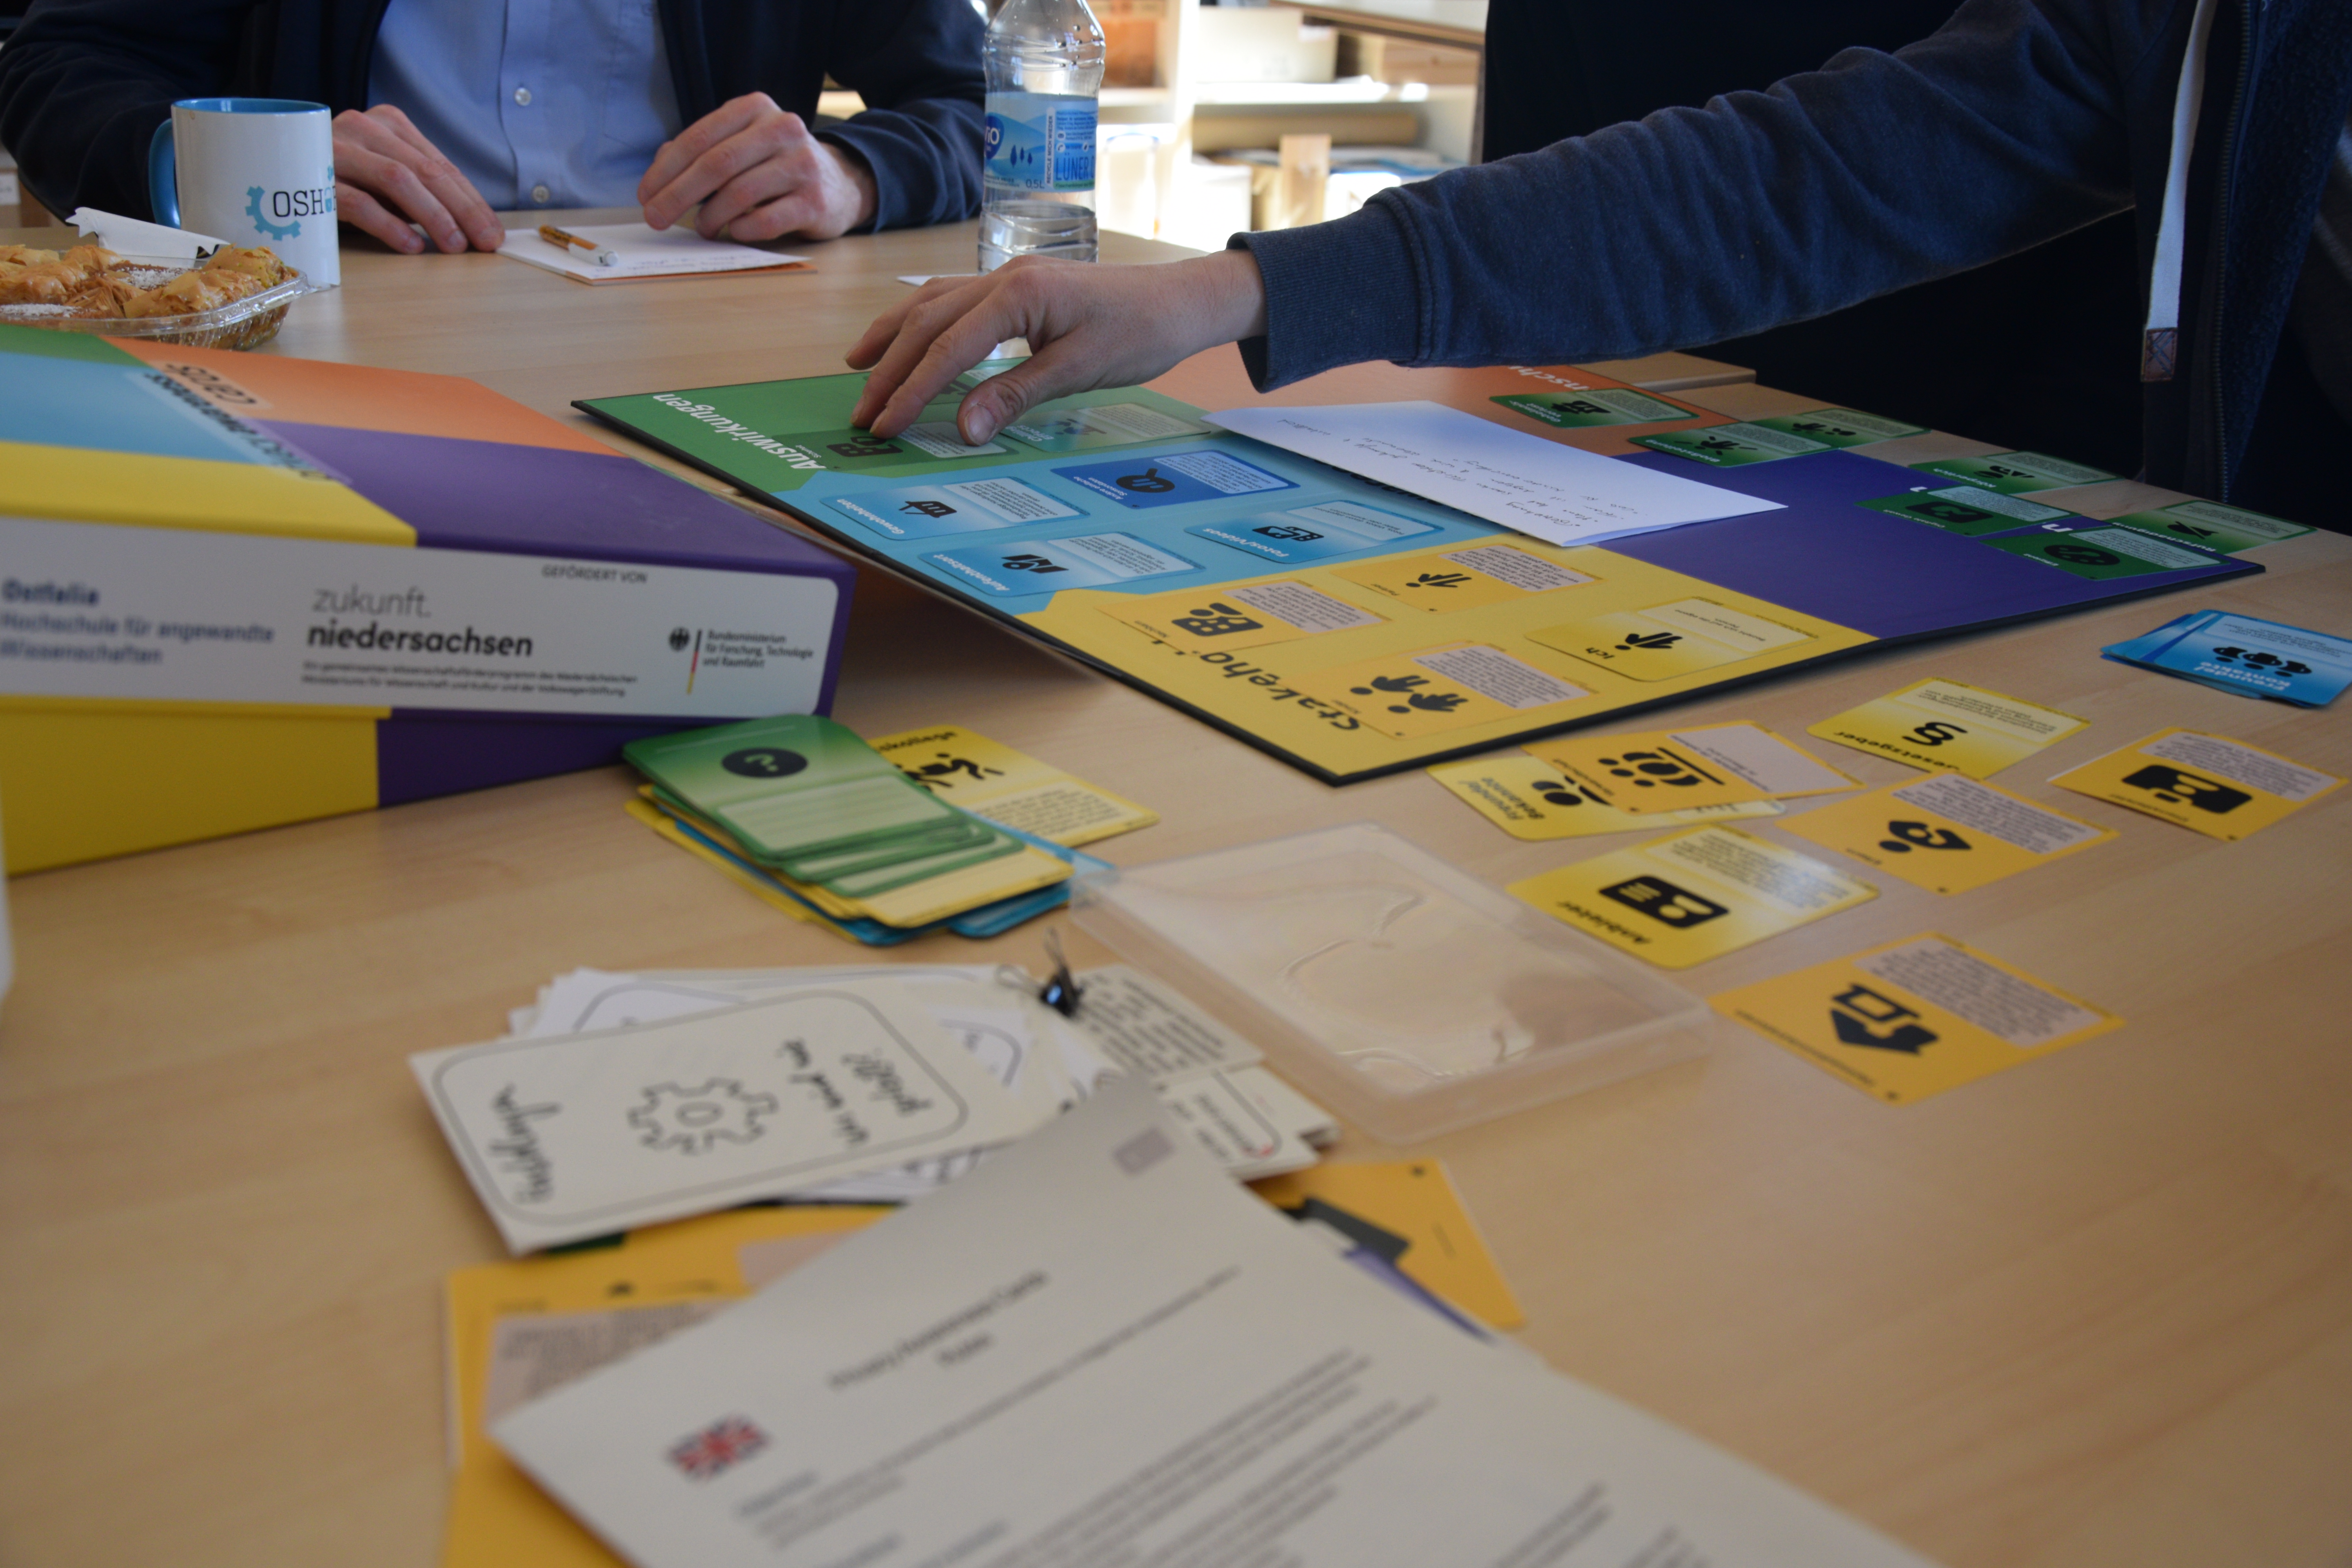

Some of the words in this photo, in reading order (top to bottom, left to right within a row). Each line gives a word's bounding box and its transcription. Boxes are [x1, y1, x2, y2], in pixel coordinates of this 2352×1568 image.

[1056, 152, 1089, 181] LÜNER
[1025, 178, 1045, 190] 0,5L
[653, 394, 826, 469] Auswirkungen
[1932, 466, 1996, 489] Körperlich
[836, 498, 905, 535] Gewohnheiten
[1202, 527, 1290, 558] Fotos/Videos
[2108, 521, 2218, 552] Rufschädigung
[541, 565, 617, 583] GEFÖRDERT
[620, 570, 649, 584] VON
[933, 554, 1011, 592] Aufenthaltsort
[2, 577, 100, 606] Ostfalia
[312, 584, 432, 619] zukunft.
[157, 622, 276, 645] angewandte
[308, 619, 533, 657] niedersachsen
[706, 629, 787, 646] Bundesministerium
[721, 655, 765, 670] Raumfahrt
[766, 644, 814, 661] Technologie
[1585, 646, 1615, 661] Ich
[2193, 666, 2285, 690] Freunde/
[2199, 661, 2291, 686] Kontakte
